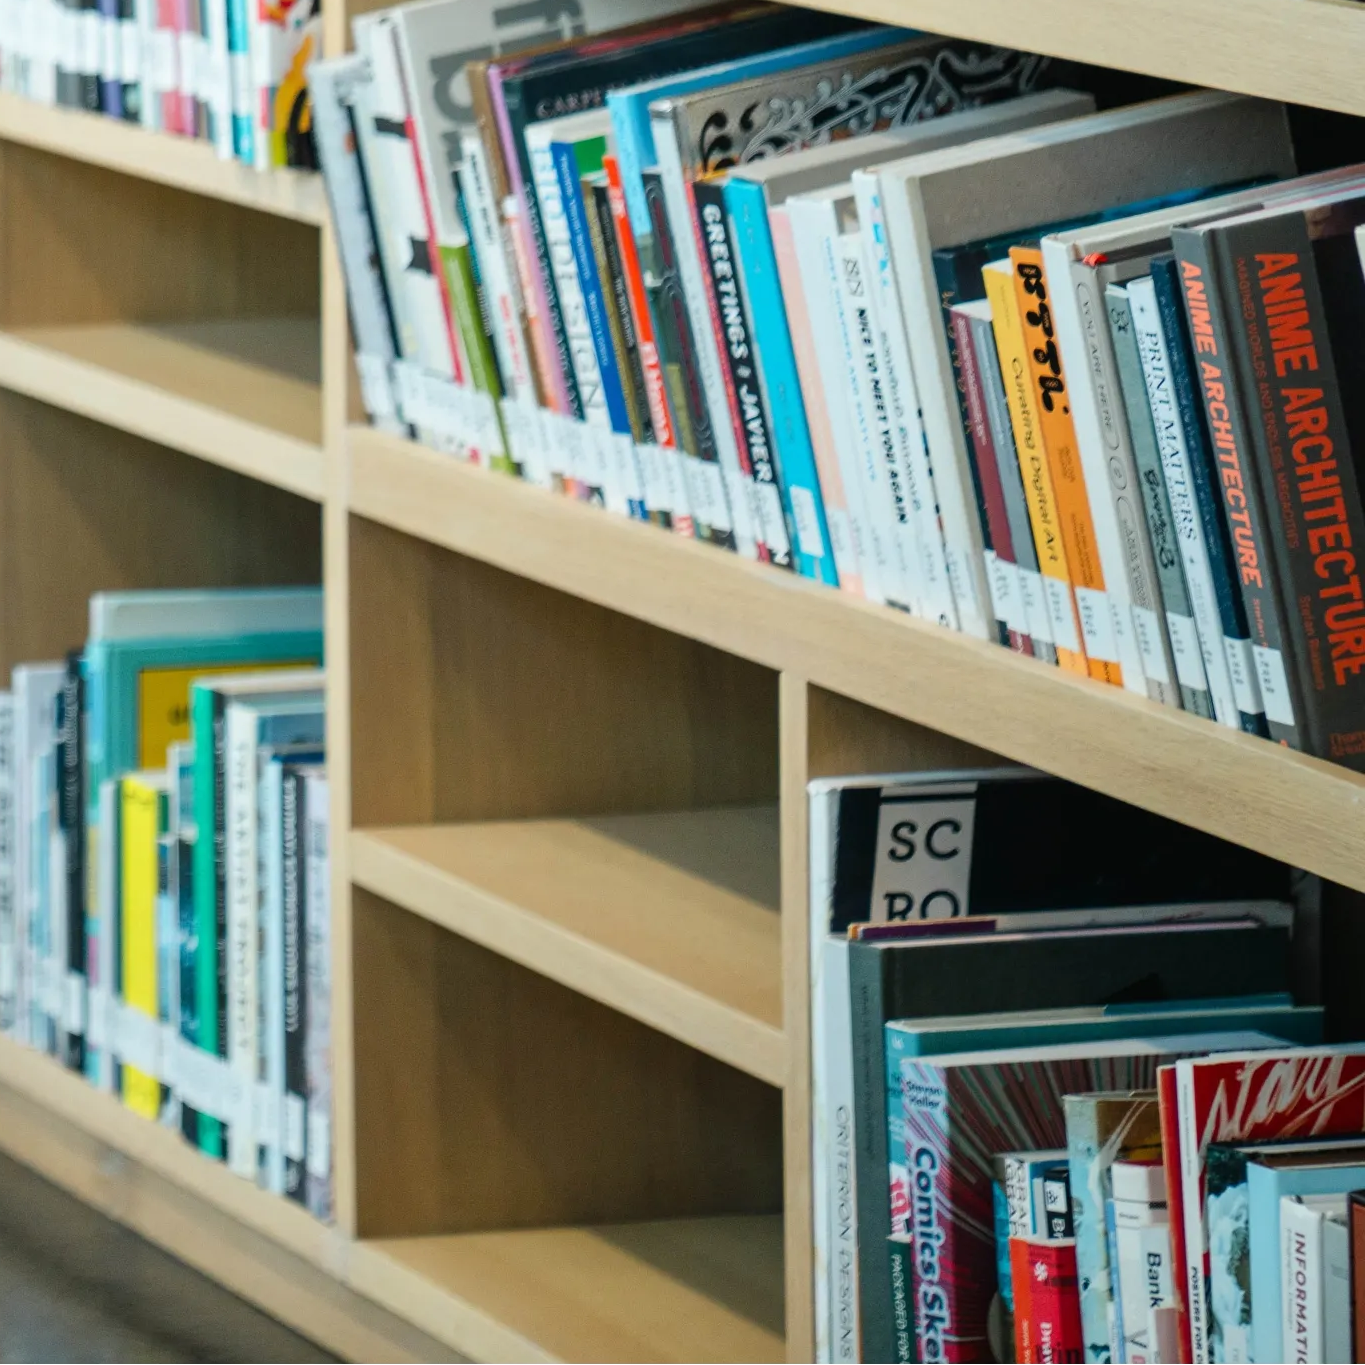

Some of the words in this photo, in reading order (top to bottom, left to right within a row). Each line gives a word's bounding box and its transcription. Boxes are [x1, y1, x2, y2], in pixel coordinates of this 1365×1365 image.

[702, 203, 750, 361] GREETINGS
[739, 385, 773, 482] JAVIER
[1248, 323, 1268, 378] WORLDS
[1259, 381, 1273, 409] AND
[1254, 253, 1319, 378] ANIME
[857, 306, 872, 344] NICE
[872, 378, 888, 423] MEET
[888, 470, 907, 524] AGAIN
[1146, 332, 1172, 404] PRINT
[1161, 413, 1197, 541] MATTERS
[1181, 260, 1218, 357] ANIME
[1201, 361, 1263, 589] ARCHITECTURE
[1280, 386, 1365, 686] ARCHITECTURE
[887, 818, 962, 863] SC
[916, 1146, 945, 1280] Comics
[839, 1248, 855, 1361] DESIGNS
[917, 1286, 951, 1365] Ske
[1147, 1252, 1165, 1308] Bank
[1194, 1330, 1205, 1351] FOR
